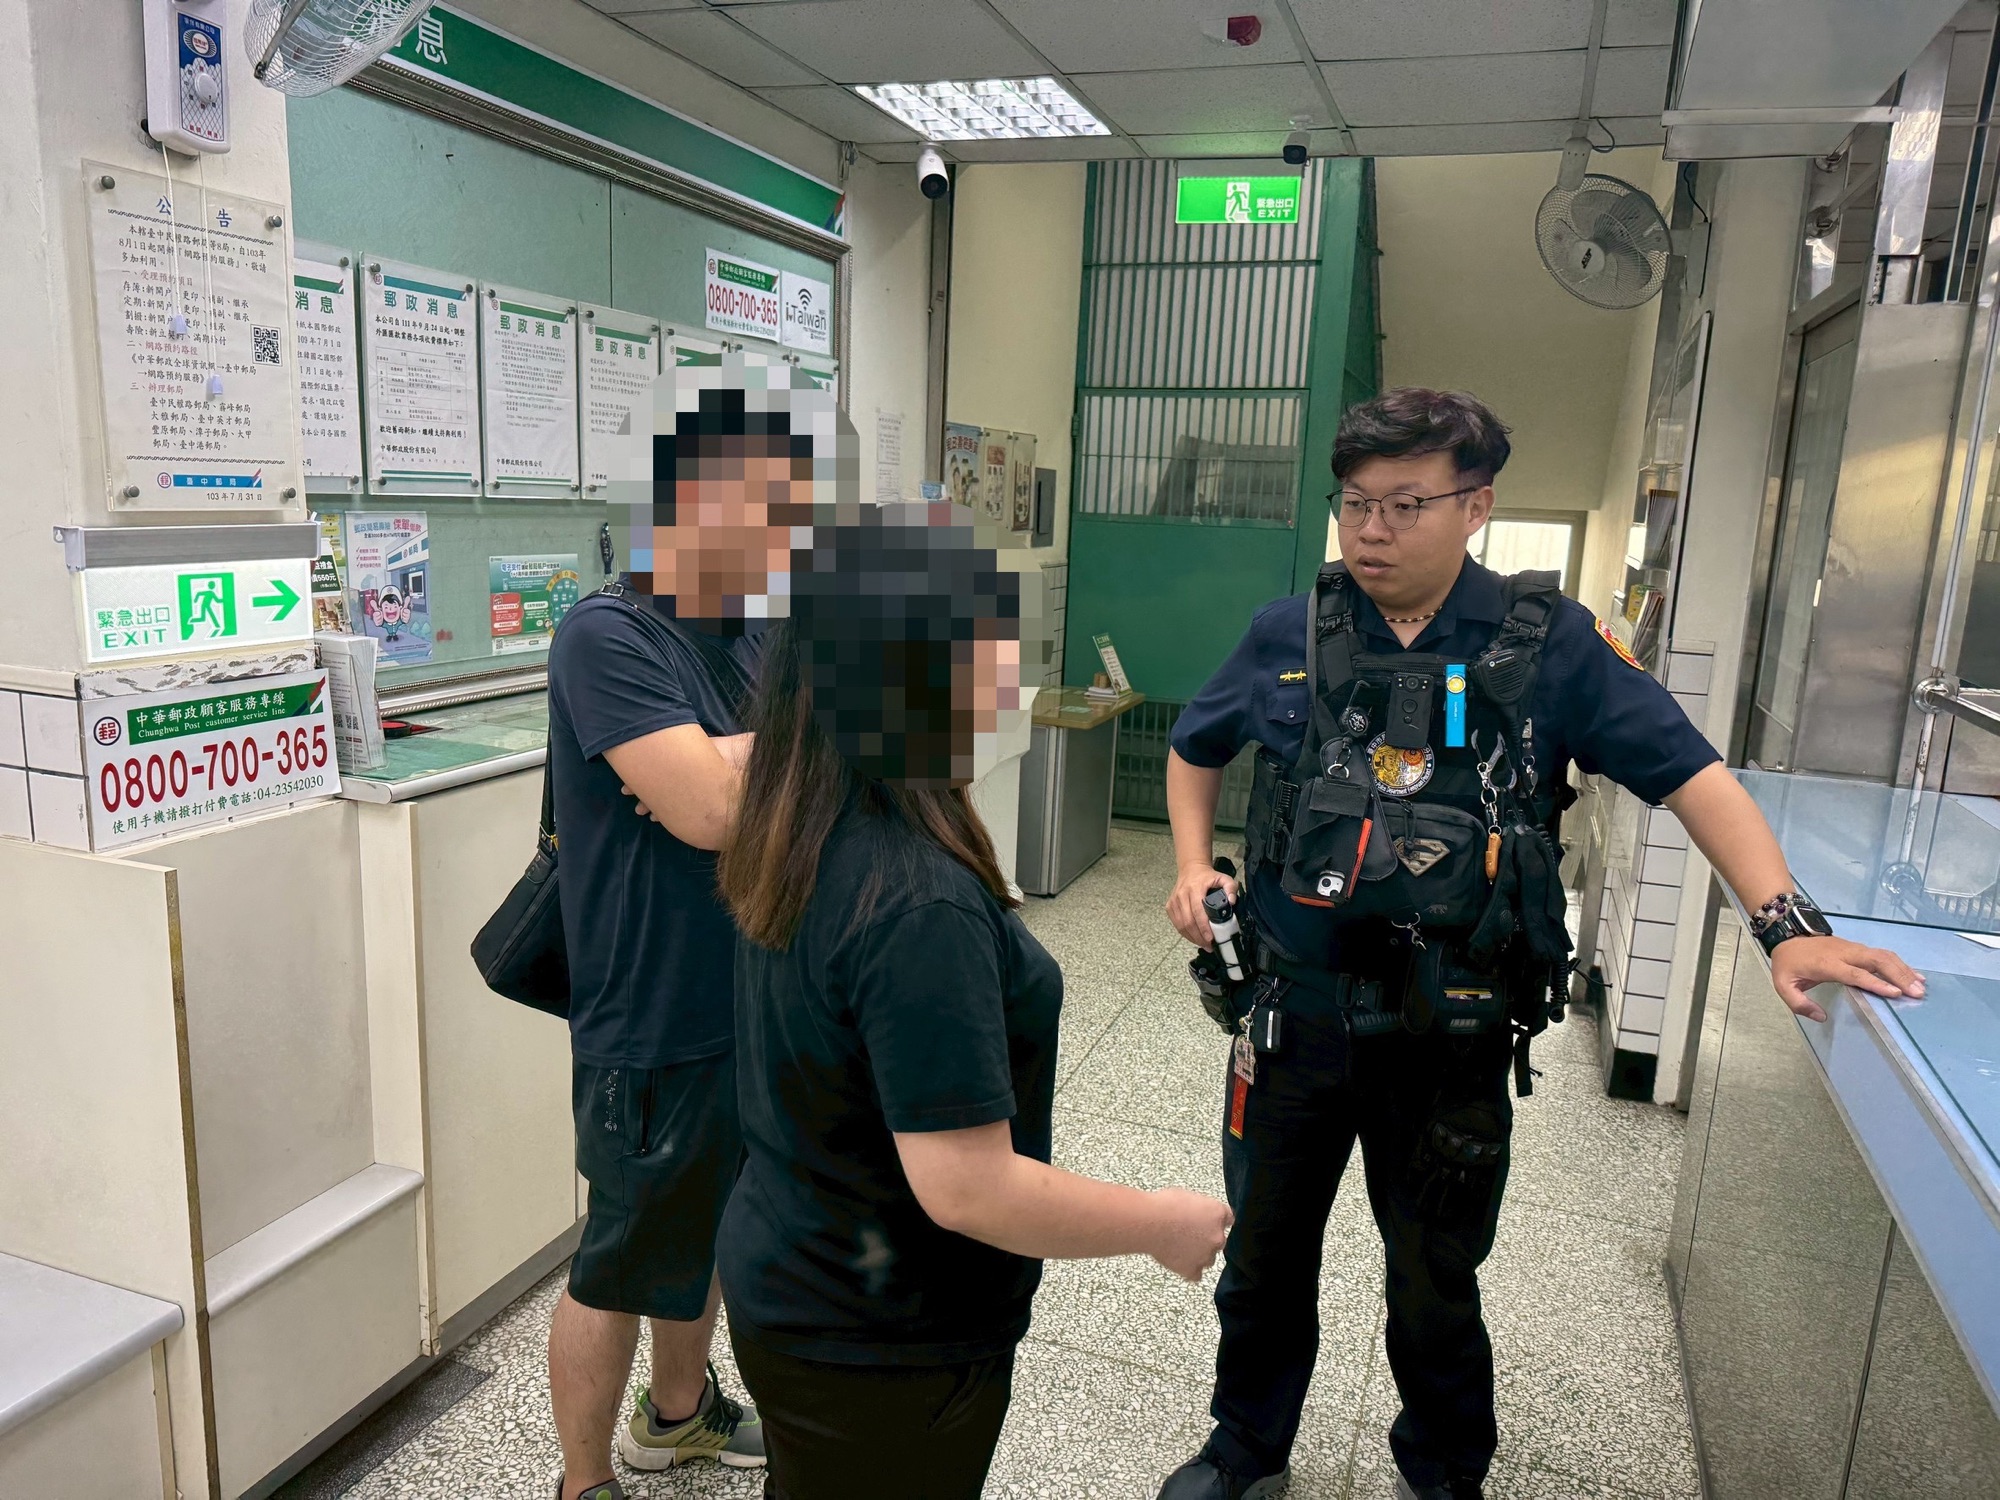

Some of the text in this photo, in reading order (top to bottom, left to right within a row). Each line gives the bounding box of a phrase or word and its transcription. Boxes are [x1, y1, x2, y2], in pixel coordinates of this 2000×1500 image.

[156, 196, 232, 228] 公告
[1258, 209, 1291, 218] EXIT
[122, 252, 164, 267] 多加利用。
[295, 290, 334, 314] 消息
[384, 290, 458, 319] 郵政消息
[708, 284, 777, 326] 0800-700-365
[296, 320, 342, 334] 紙本國際郵政
[500, 314, 561, 340] 郵政消息
[127, 340, 198, 356] 二、網路預約路徑
[130, 382, 184, 394] 三、辦理郵局
[150, 397, 251, 414] 臺中民權路郵局、霧峰郵局
[151, 410, 251, 426] 大雅郵局、臺中英才郵局
[152, 424, 252, 439] 豐原郵局、潭子郵局、大甲
[153, 439, 227, 450] 郵局、臺中港郵局。
[98, 607, 170, 628] 緊急出口
[104, 629, 167, 648] EXIT
[136, 691, 286, 728] 中華郵政顧客服務專線
[138, 707, 285, 738] Chunghwa Post customer service line
[101, 725, 327, 812] 0800-700-365
[112, 775, 324, 834] 使用手機請撥打付費電話:04-23542030
